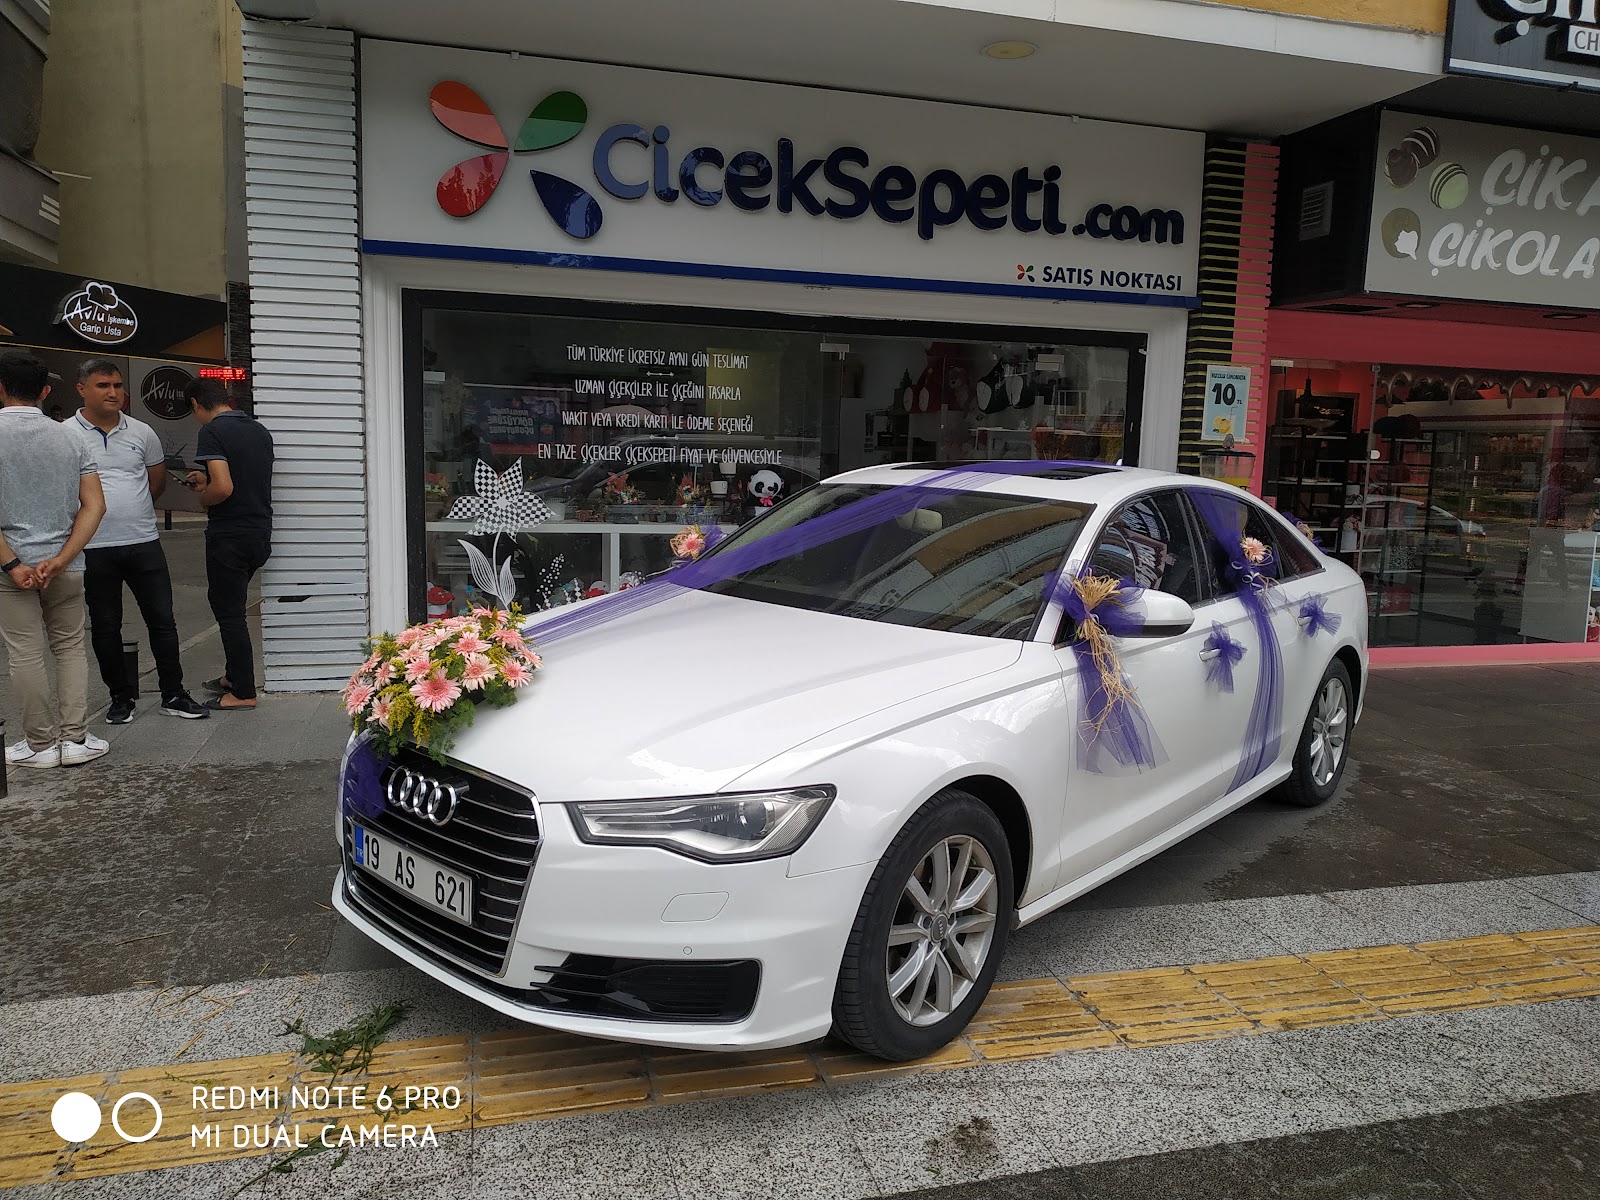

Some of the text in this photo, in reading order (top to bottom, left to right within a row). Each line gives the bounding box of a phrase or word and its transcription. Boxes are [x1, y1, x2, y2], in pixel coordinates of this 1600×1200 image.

[1042, 265, 1182, 291] SATIŞ NOKTASI
[62, 297, 105, 323] Avlu
[79, 322, 122, 337] Garip Usta
[566, 344, 750, 370] TÜM TÜRKİYE ÜCRETSİZ AYNI GÜN TESLİMAT
[142, 374, 175, 400] Avlu
[574, 378, 605, 395] UZMAN
[608, 379, 653, 400] ÇİÇEKÇİLER
[655, 381, 669, 398] İLE
[707, 385, 741, 401] TASARLA
[1211, 382, 1236, 406] 10
[561, 409, 753, 435] NAKİT VEYA KREDİ KARTI İLE ÖDEME SEÇENEĞİ
[537, 443, 782, 465] EN TAZE ÇİÇEKLER ÇİÇEKSEPETİ FİYAT VE GÜVENCESİYLE
[364, 834, 465, 916] 19 AS 621
